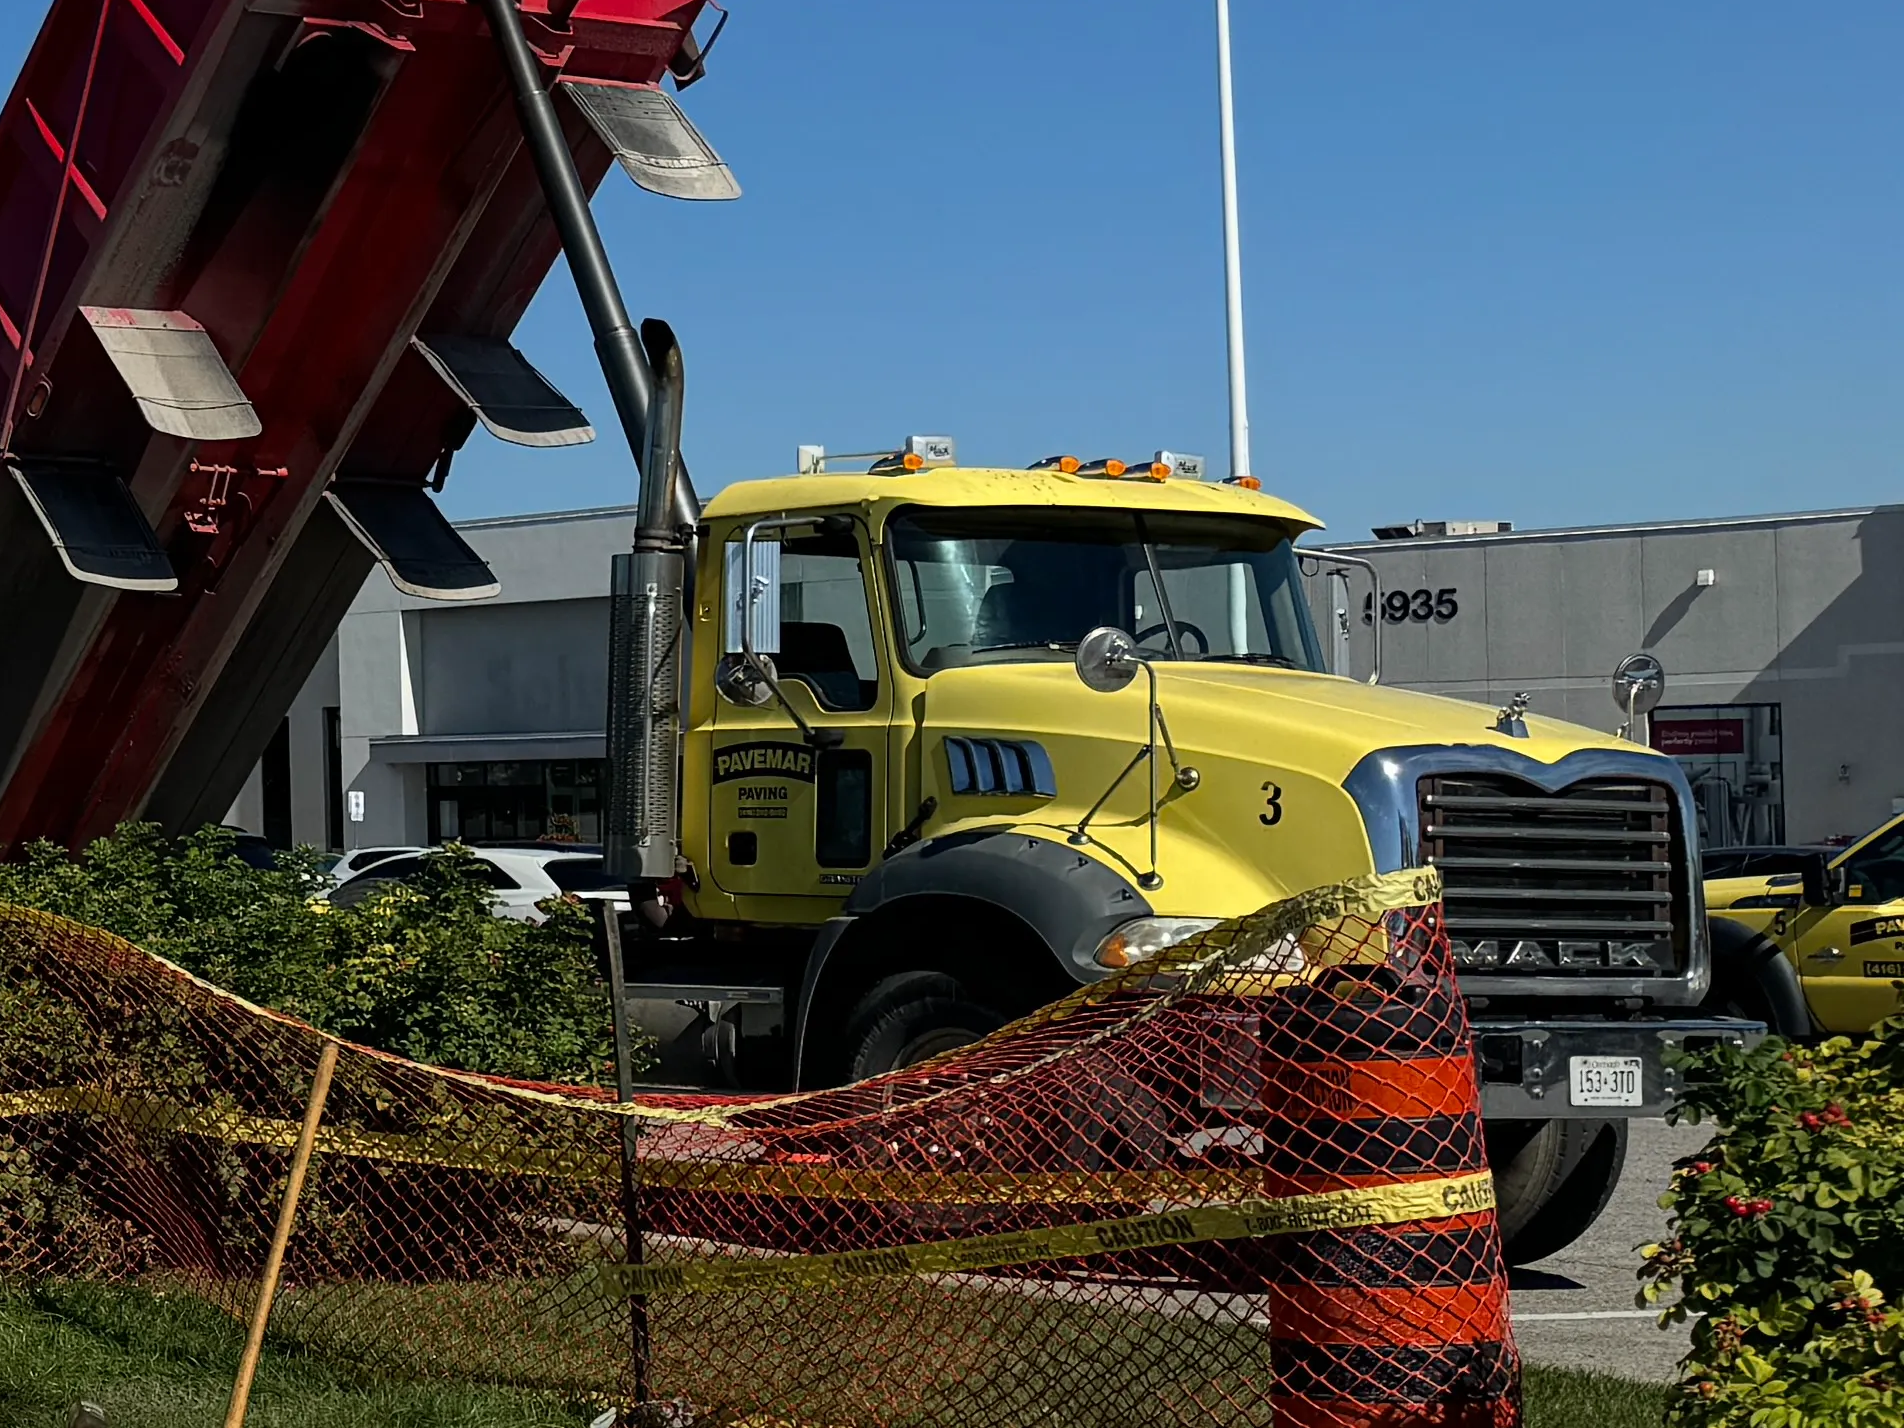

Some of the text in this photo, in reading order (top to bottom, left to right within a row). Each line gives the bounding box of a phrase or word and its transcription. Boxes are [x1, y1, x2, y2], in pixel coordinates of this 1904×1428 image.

[1364, 588, 1458, 622] 5935
[717, 749, 811, 775] PAVEMAR
[738, 787, 788, 800] PAVING
[1259, 781, 1282, 825] 3
[1774, 910, 1787, 936] 5
[1448, 940, 1660, 967] MACK
[1095, 1214, 1196, 1248] CAUTION
